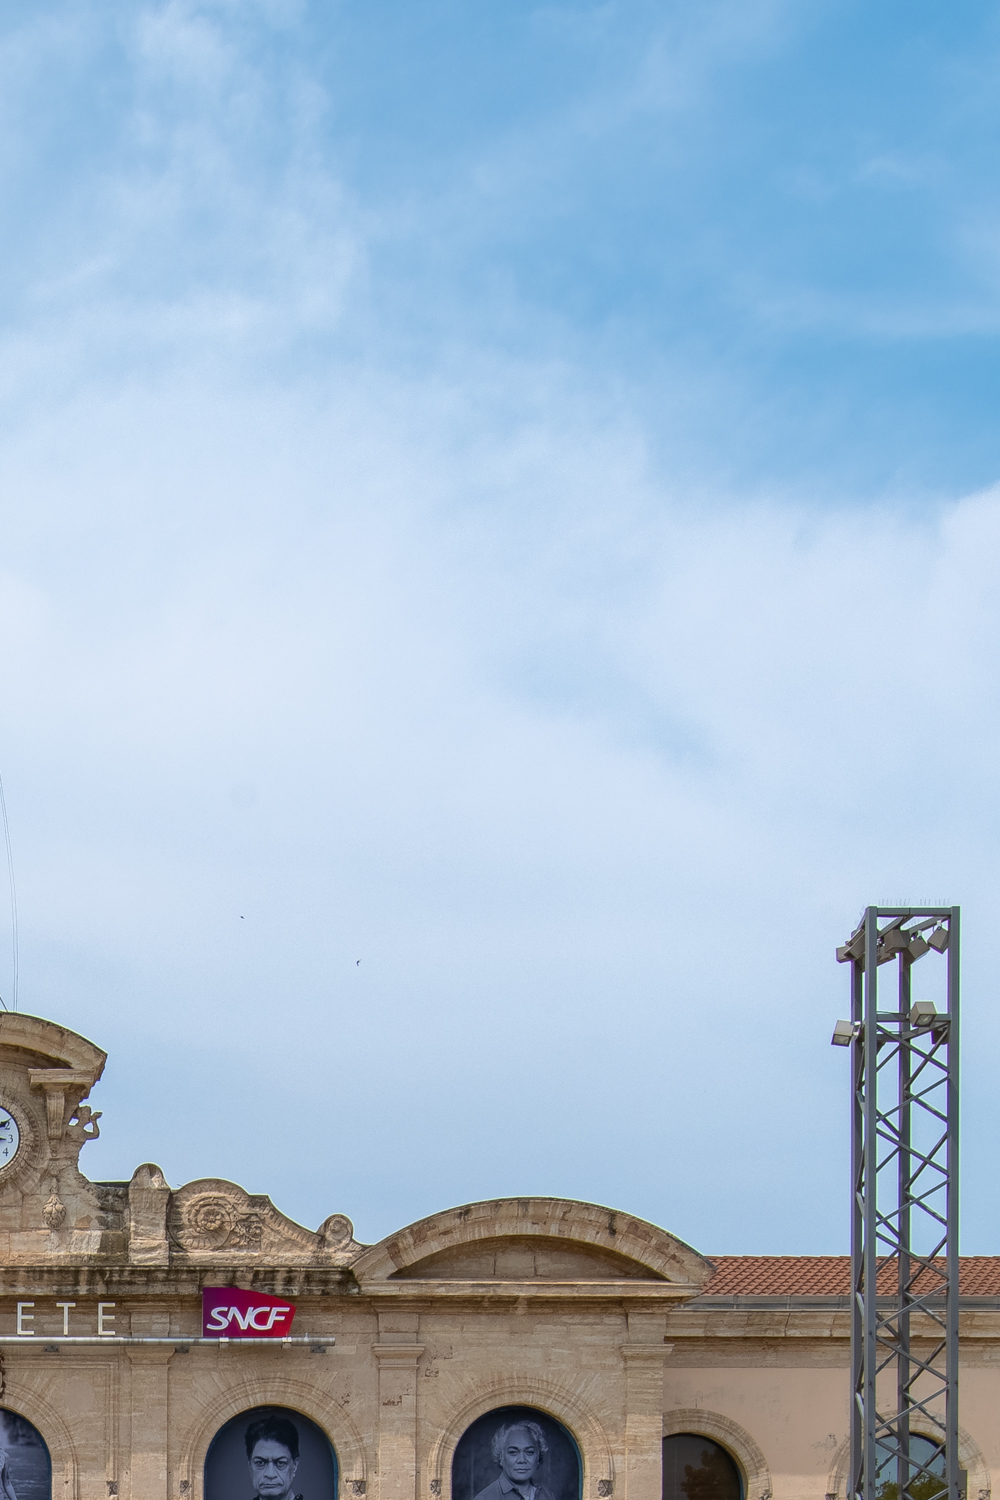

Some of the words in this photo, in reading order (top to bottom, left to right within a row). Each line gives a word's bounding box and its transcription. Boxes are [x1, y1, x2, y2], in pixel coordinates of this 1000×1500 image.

[4, 1120, 11, 1130] 2
[8, 1134, 14, 1144] 3
[2, 1147, 8, 1157] 4
[206, 1306, 291, 1331] SNCF
